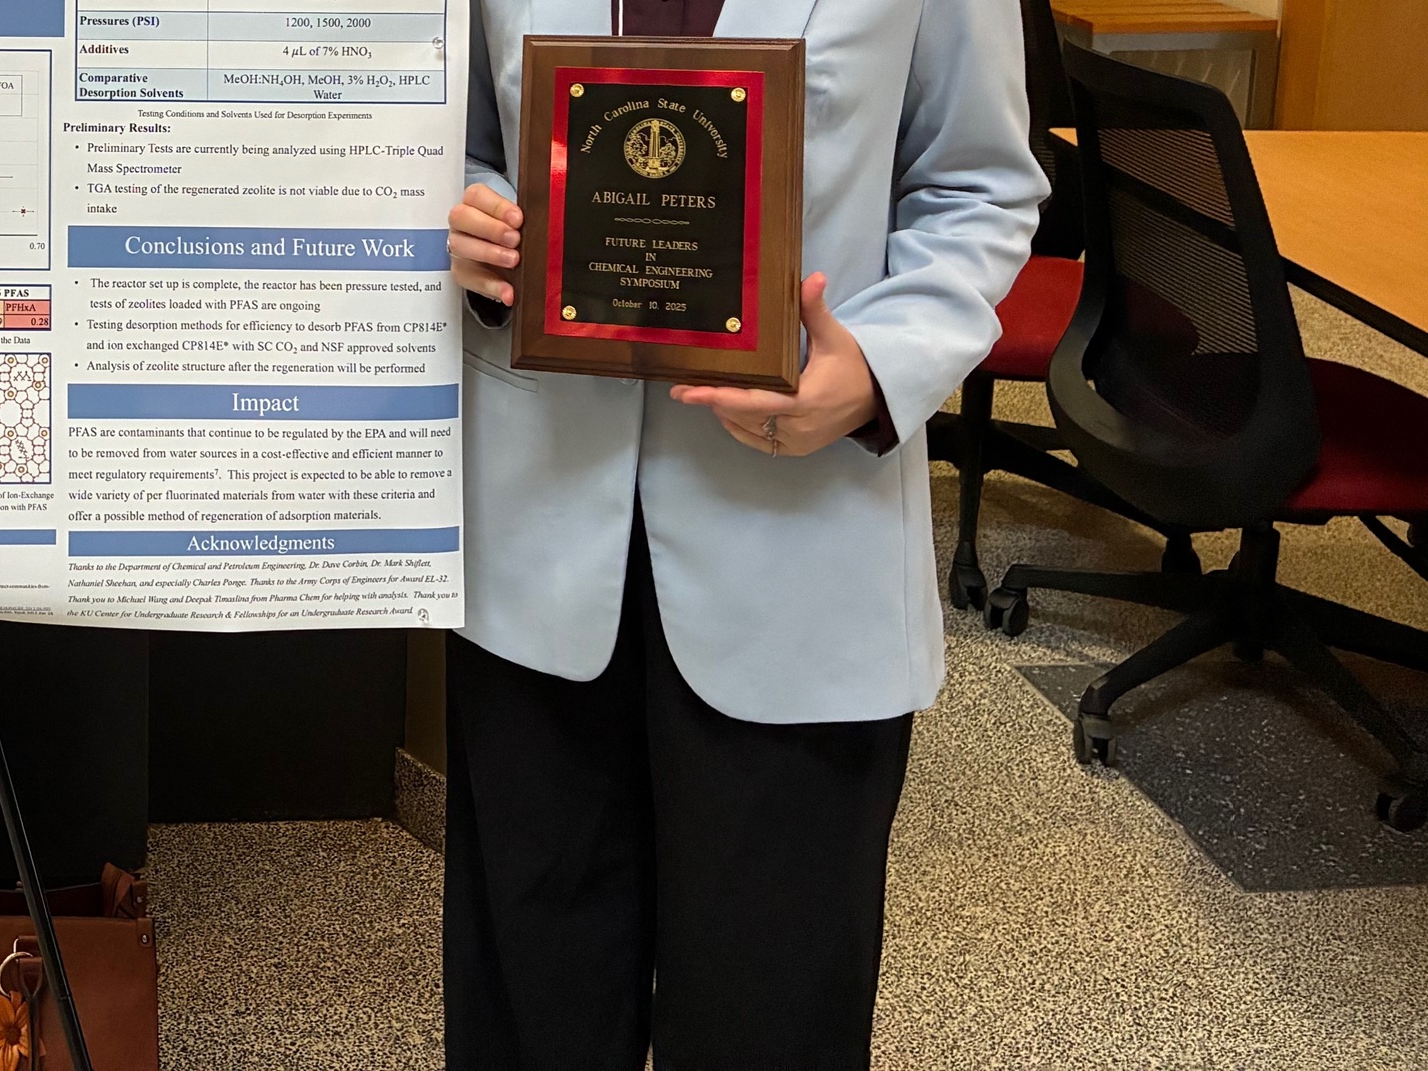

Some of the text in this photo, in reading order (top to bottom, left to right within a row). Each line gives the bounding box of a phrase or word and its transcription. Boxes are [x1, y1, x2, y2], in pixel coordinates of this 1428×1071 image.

[79, 15, 159, 27] Pressures (PSI)
[285, 16, 371, 29] 1200, 1500, 2000
[78, 43, 129, 54] Additives
[63, 122, 171, 135] Preliminary Results:
[581, 124, 602, 154] North
[604, 100, 649, 122] Carolina
[657, 98, 686, 113] State
[86, 162, 182, 176] Mass Spectrometer
[592, 191, 715, 207] ABIGAIL PETERS
[124, 235, 414, 257] Conclusions and Future Work
[605, 237, 697, 250] FUTURE LEADERS
[589, 262, 712, 277] CHEMICAL ENGINEERING
[620, 277, 679, 288] SYMPOSIUM
[89, 297, 321, 313] tests of zeolites loaded with PFAS are ongoing
[665, 302, 685, 311] 2025
[232, 392, 299, 416] Impact
[186, 534, 335, 554] Acknowledgments
